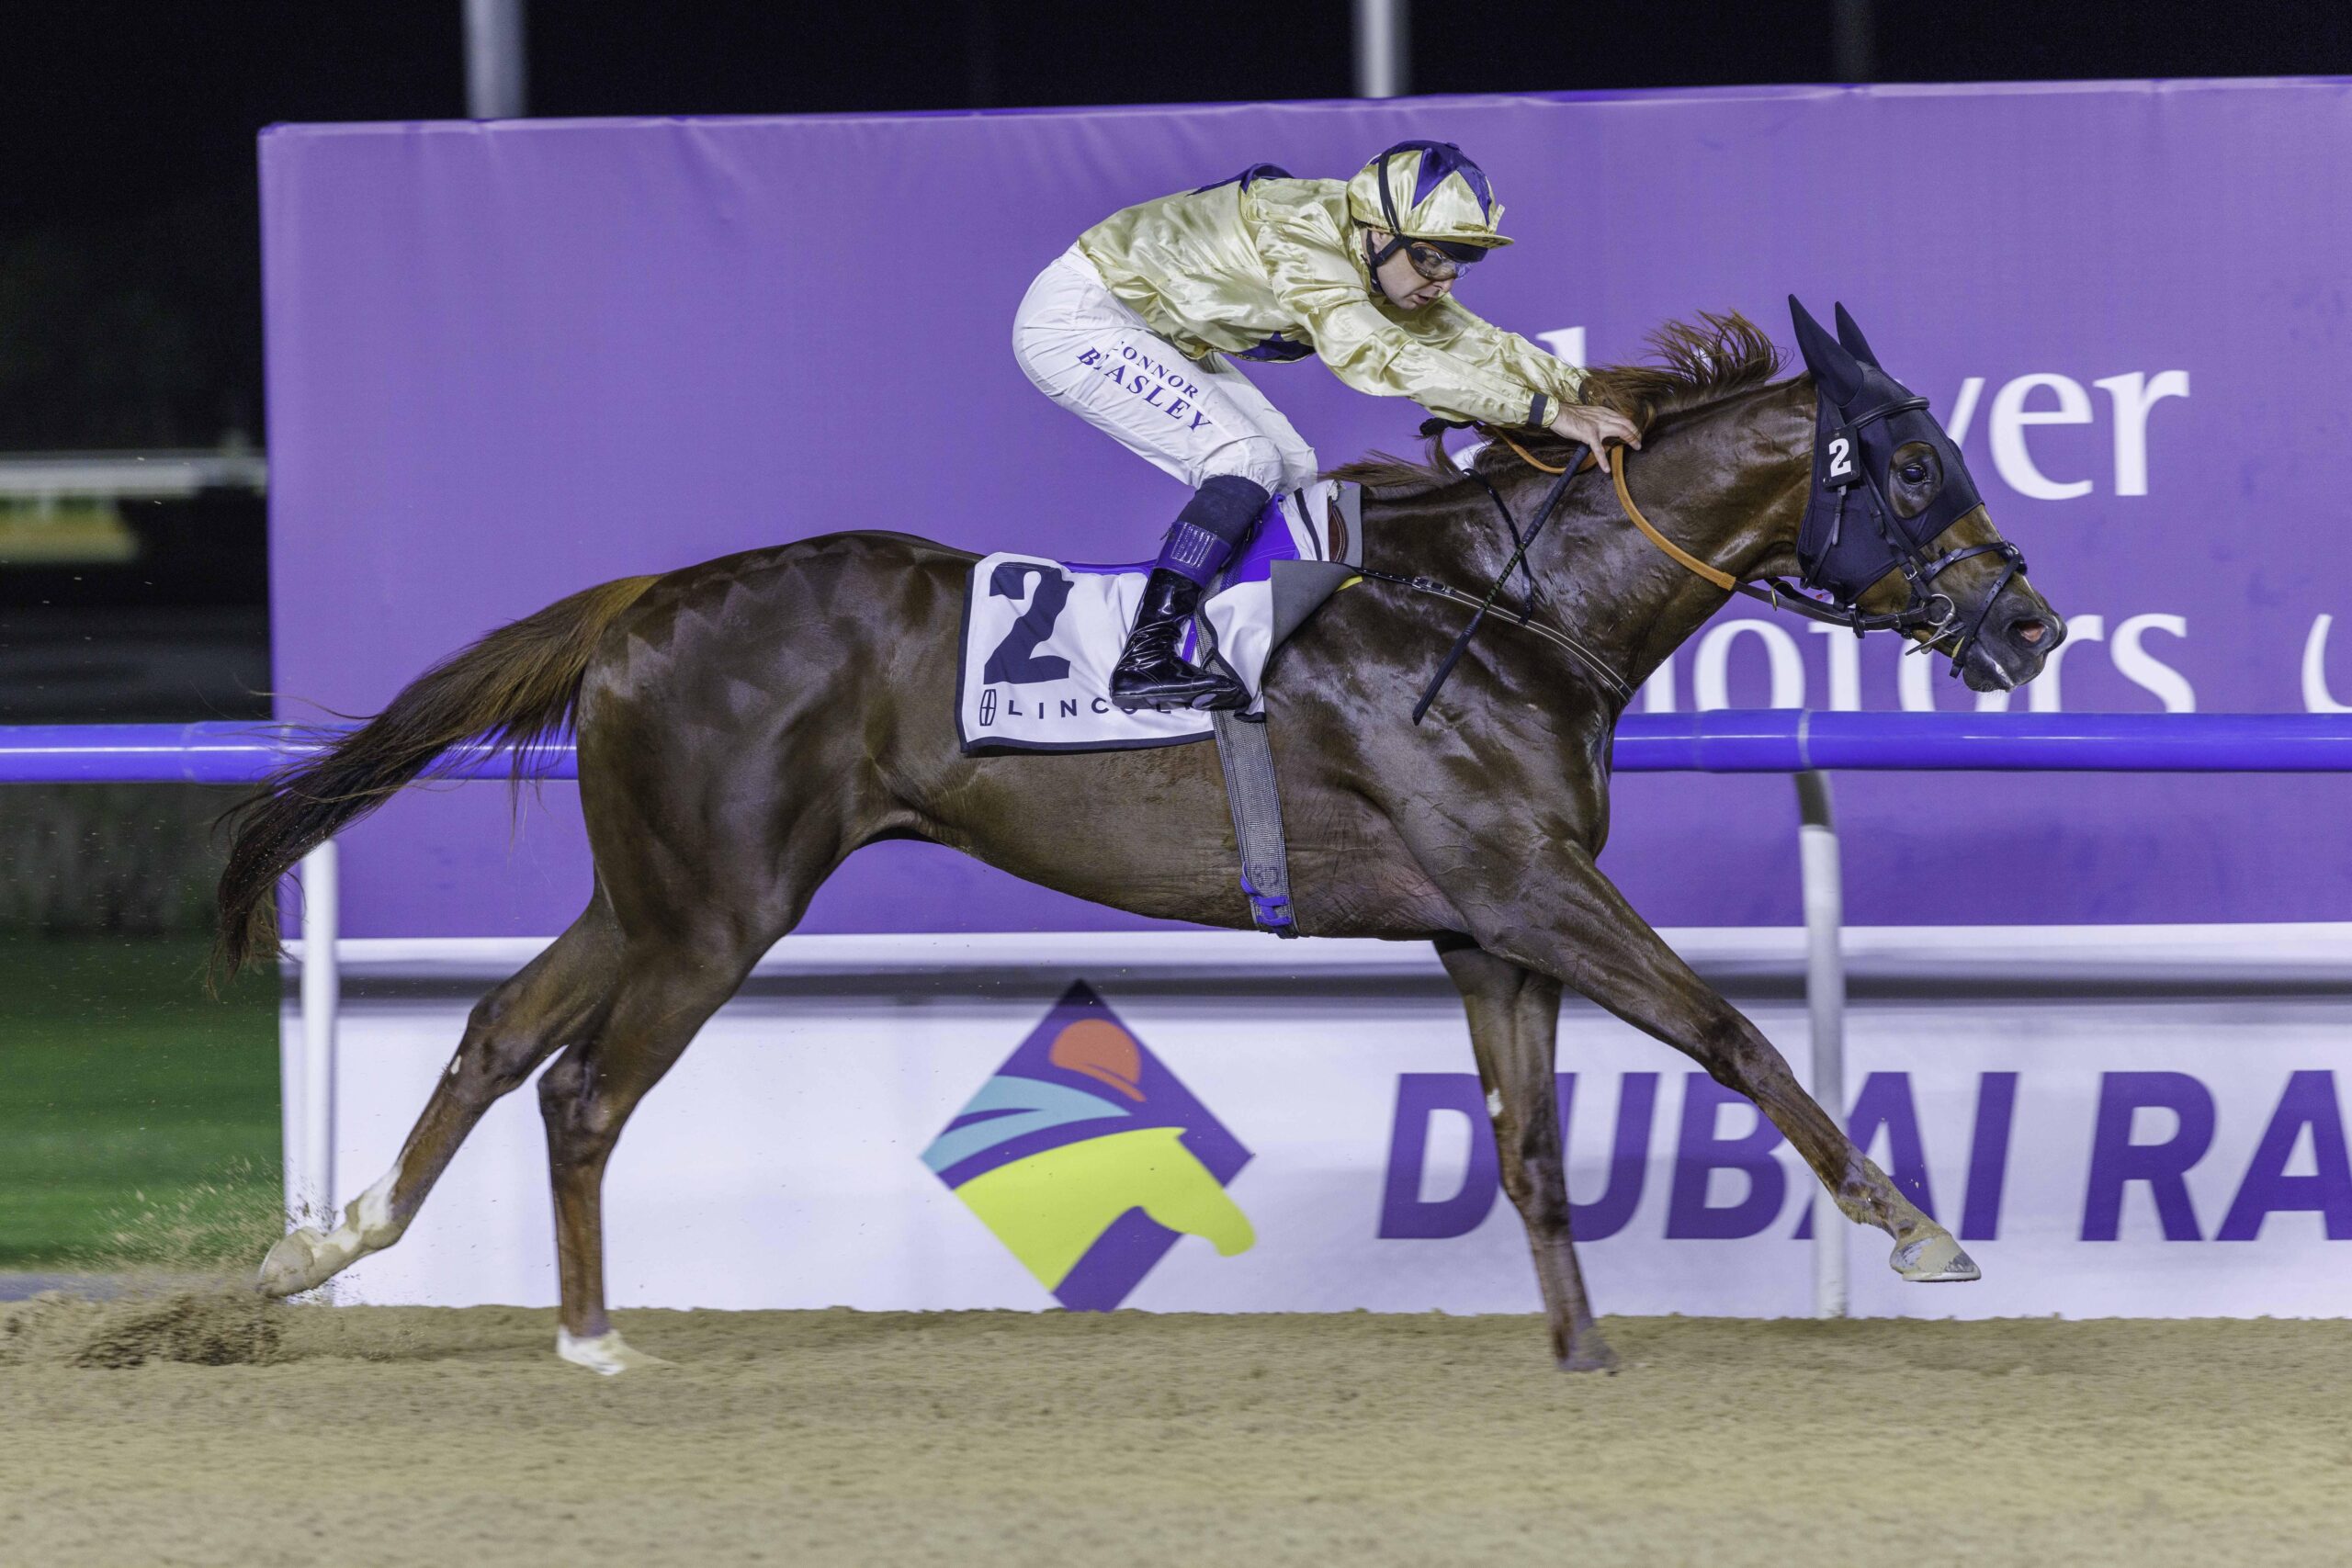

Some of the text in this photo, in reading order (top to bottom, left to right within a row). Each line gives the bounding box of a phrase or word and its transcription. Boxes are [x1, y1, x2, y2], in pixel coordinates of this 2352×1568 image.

[1077, 346, 1213, 431] BASLEY
[1113, 341, 1199, 399] ONNOR
[1828, 437, 1852, 478] 2
[983, 561, 1075, 685] 2
[1008, 696, 1194, 720] LINCL
